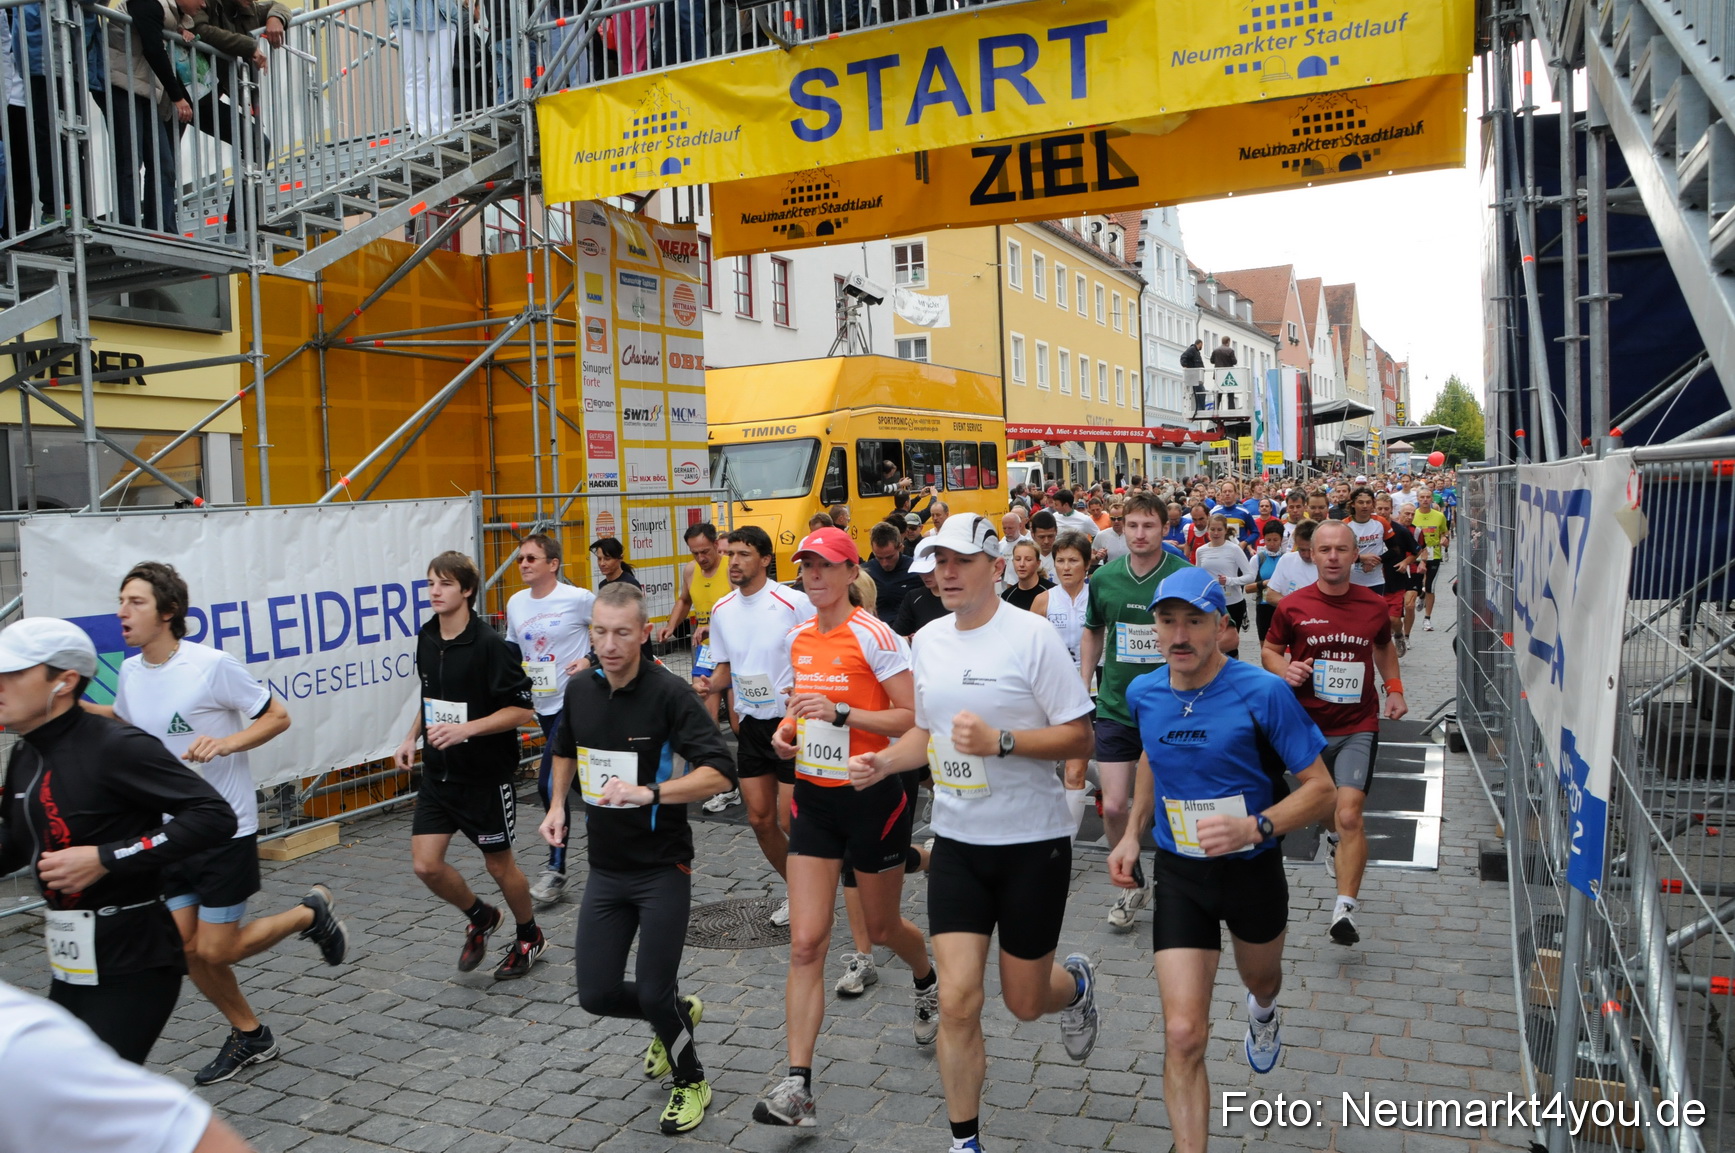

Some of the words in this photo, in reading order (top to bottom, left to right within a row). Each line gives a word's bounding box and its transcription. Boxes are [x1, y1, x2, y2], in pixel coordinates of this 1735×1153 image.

[1171, 30, 1297, 68] Neumarkter
[1303, 12, 1409, 48] Stadtlauf
[789, 20, 1108, 143] START
[573, 138, 662, 165] Neumarkter
[665, 125, 742, 151] Stadtlauf
[1238, 136, 1341, 162] Neumarkter
[1343, 120, 1425, 150] Stadtlauf
[969, 130, 1140, 207] ZIEL
[739, 203, 816, 226] Neumarkter
[818, 195, 884, 217] Stadtlauf
[656, 238, 699, 257] MERZ
[672, 302, 697, 312] WITTMANN
[669, 352, 705, 371] OBI
[583, 361, 612, 376] Sinupret
[583, 375, 601, 388] forte
[623, 408, 650, 421] swn
[671, 407, 697, 422] MCM
[742, 424, 798, 439] TIMING
[953, 421, 966, 432] EVENT
[966, 422, 983, 433] SERVICE
[1079, 429, 1112, 437] Serviceline:
[588, 480, 619, 488] HACKNER
[631, 518, 668, 534] Sinupret
[633, 535, 654, 550] forte
[645, 582, 674, 595] Egner
[1126, 603, 1147, 611] BECK'S
[1127, 627, 1154, 637] Matthias
[1129, 639, 1158, 650] 3047
[1306, 632, 1370, 647] Gasthaus
[1320, 650, 1356, 662] Rupp
[1328, 664, 1347, 674] Peter
[796, 671, 850, 684] SportScheck
[1328, 677, 1359, 689] 2970
[742, 686, 769, 698] 2662
[435, 710, 461, 725] 3484
[1166, 729, 1208, 740] ERTEL
[806, 741, 844, 762] 1004
[590, 756, 612, 768] Horst
[943, 760, 973, 779] 988
[1183, 799, 1216, 812] Alfons
